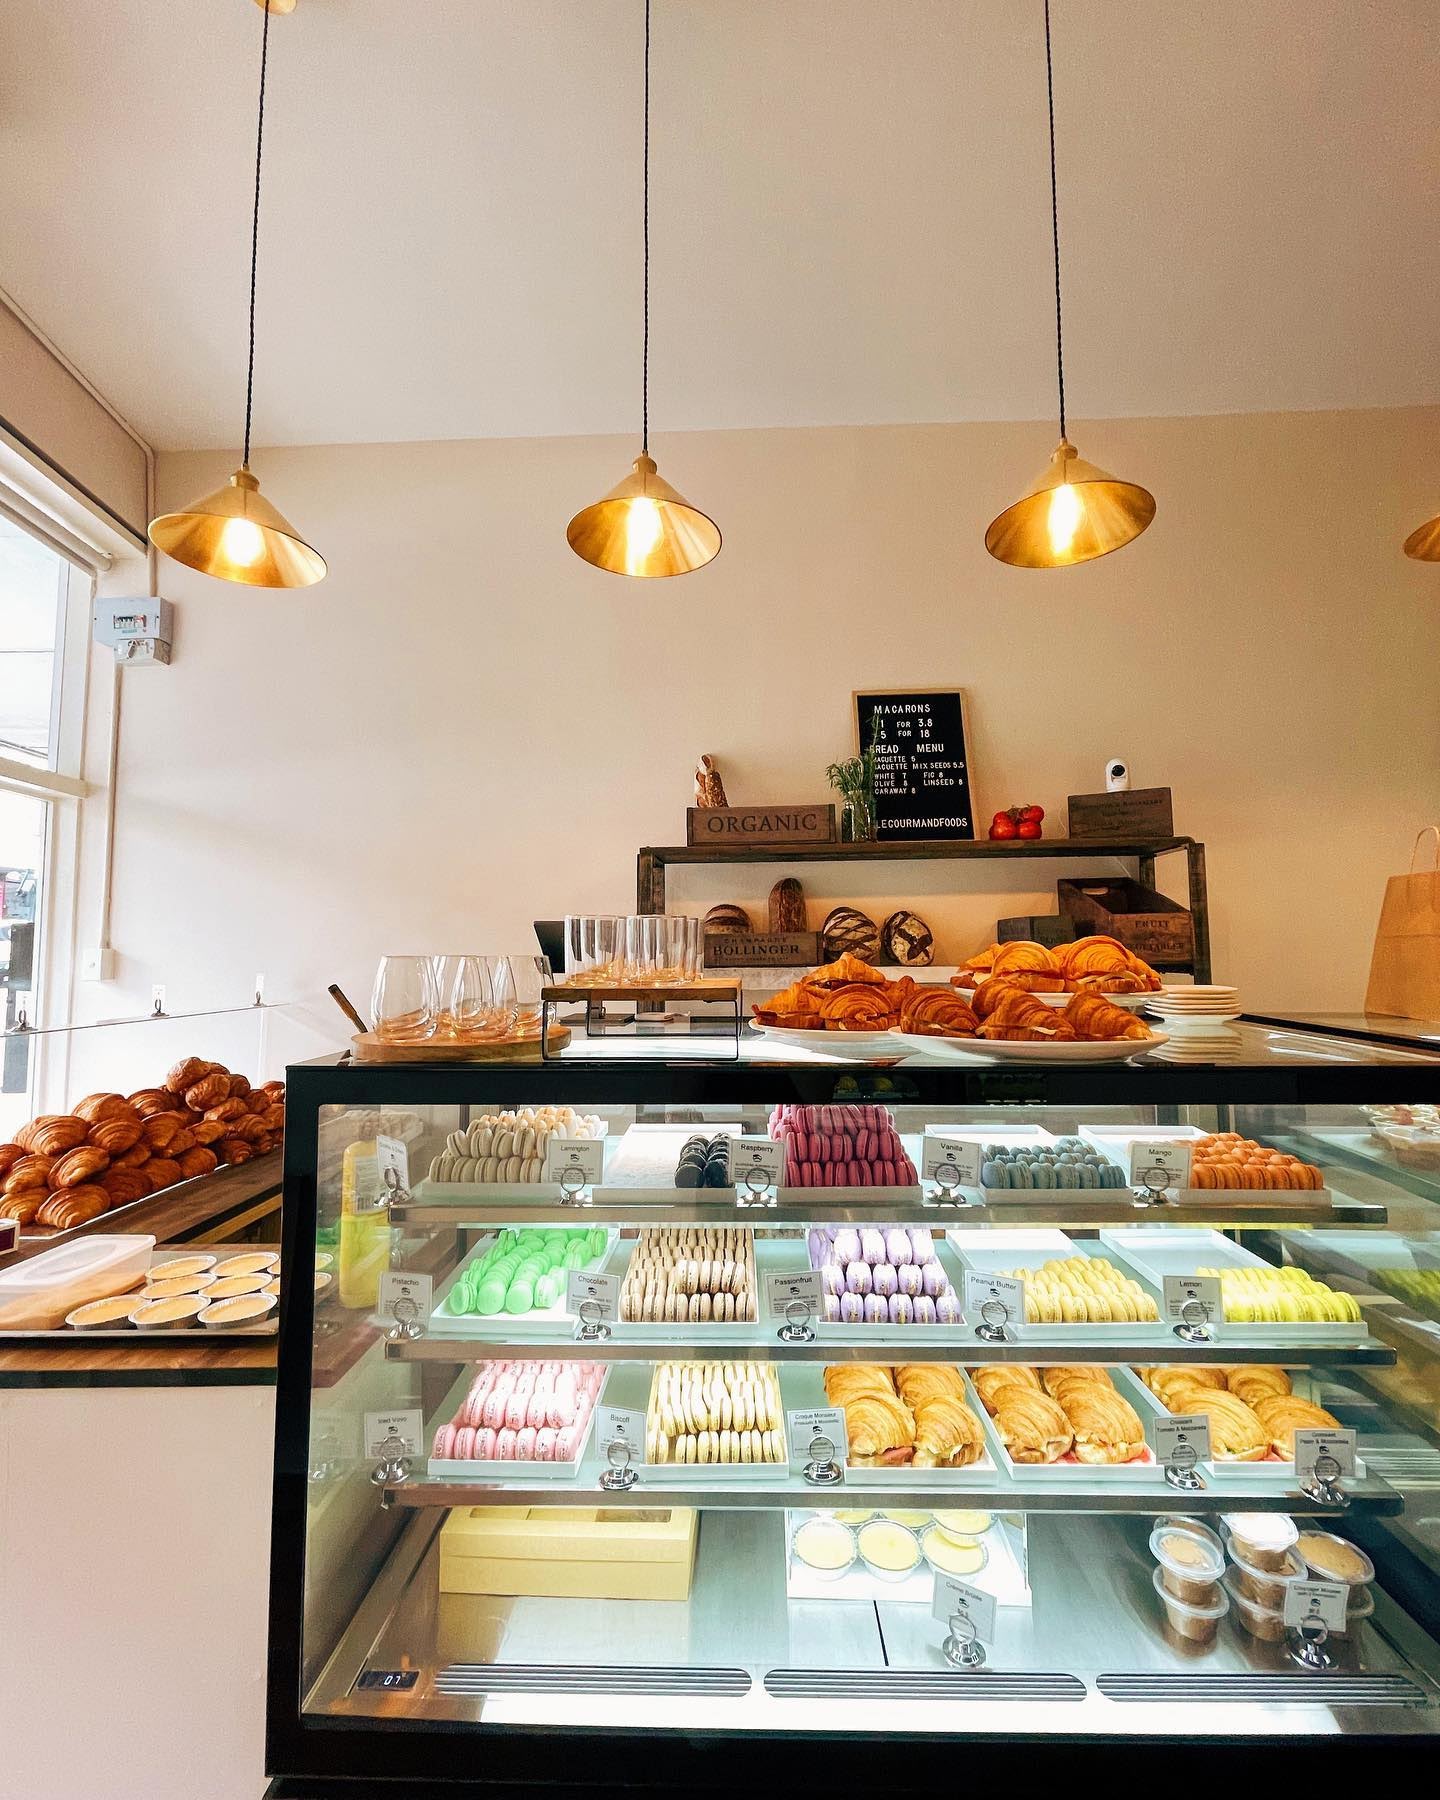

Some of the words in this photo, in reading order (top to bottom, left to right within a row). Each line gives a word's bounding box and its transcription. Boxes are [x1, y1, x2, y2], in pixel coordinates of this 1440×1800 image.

[874, 704, 931, 714] MACARONS
[880, 719, 884, 728] 1
[918, 718, 933, 727] 3.8
[880, 730, 887, 739] 5
[920, 729, 930, 738] 18
[916, 743, 944, 753] MENU
[873, 755, 906, 763] AGUETTE
[912, 762, 928, 770] MIX
[874, 772, 895, 780] WHITE
[874, 787, 907, 795] CARAWAY
[707, 813, 817, 833] ORGANIC
[1135, 920, 1169, 928] FRUIT
[713, 944, 800, 956] BOLLINGER
[561, 1145, 590, 1153] Lamington
[740, 1143, 774, 1153] Raspberry
[940, 1143, 963, 1152] Vanilla
[1149, 1148, 1172, 1157] Mango
[578, 1275, 608, 1285] Chocolate
[774, 1277, 813, 1285] Passionfruit
[971, 1276, 995, 1286] Peanut
[996, 1280, 1017, 1289] Butter
[1180, 1280, 1202, 1288] Lemon
[611, 1414, 630, 1423] Biscoff
